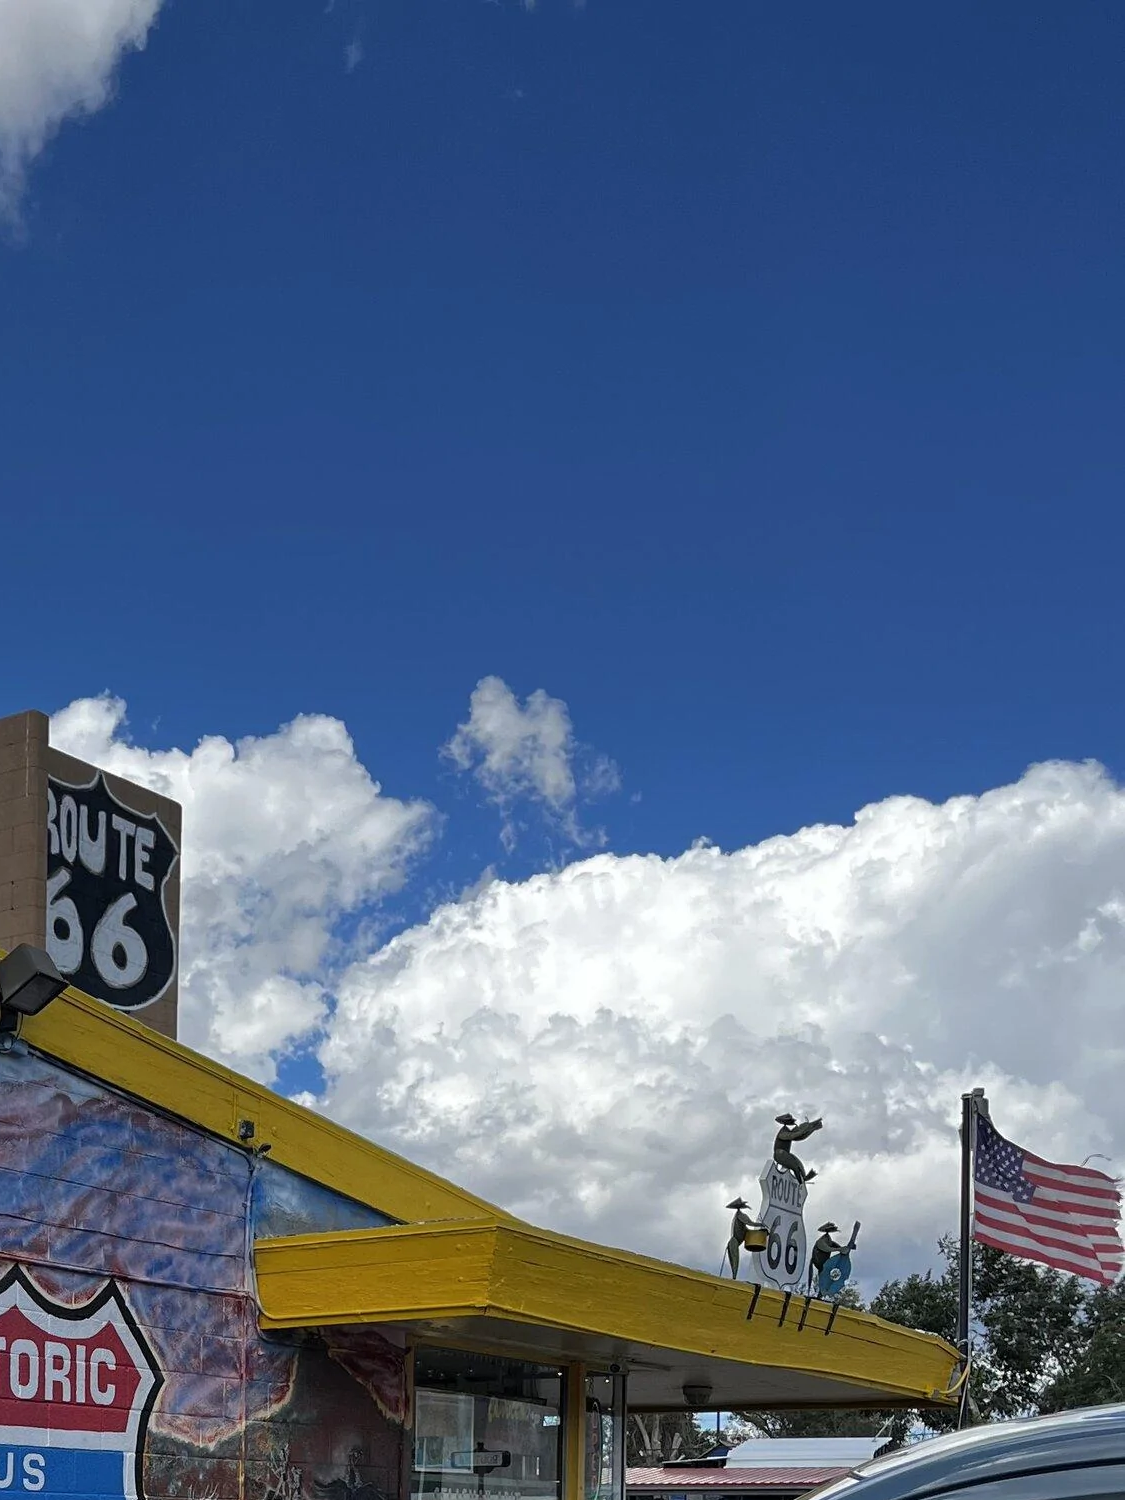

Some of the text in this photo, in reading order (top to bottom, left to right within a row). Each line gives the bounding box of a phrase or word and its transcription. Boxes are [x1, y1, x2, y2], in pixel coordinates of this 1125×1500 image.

[47, 787, 156, 892] ROUTE
[46, 865, 149, 990] 66
[773, 1175, 803, 1208] ROUTE
[768, 1216, 799, 1275] 66
